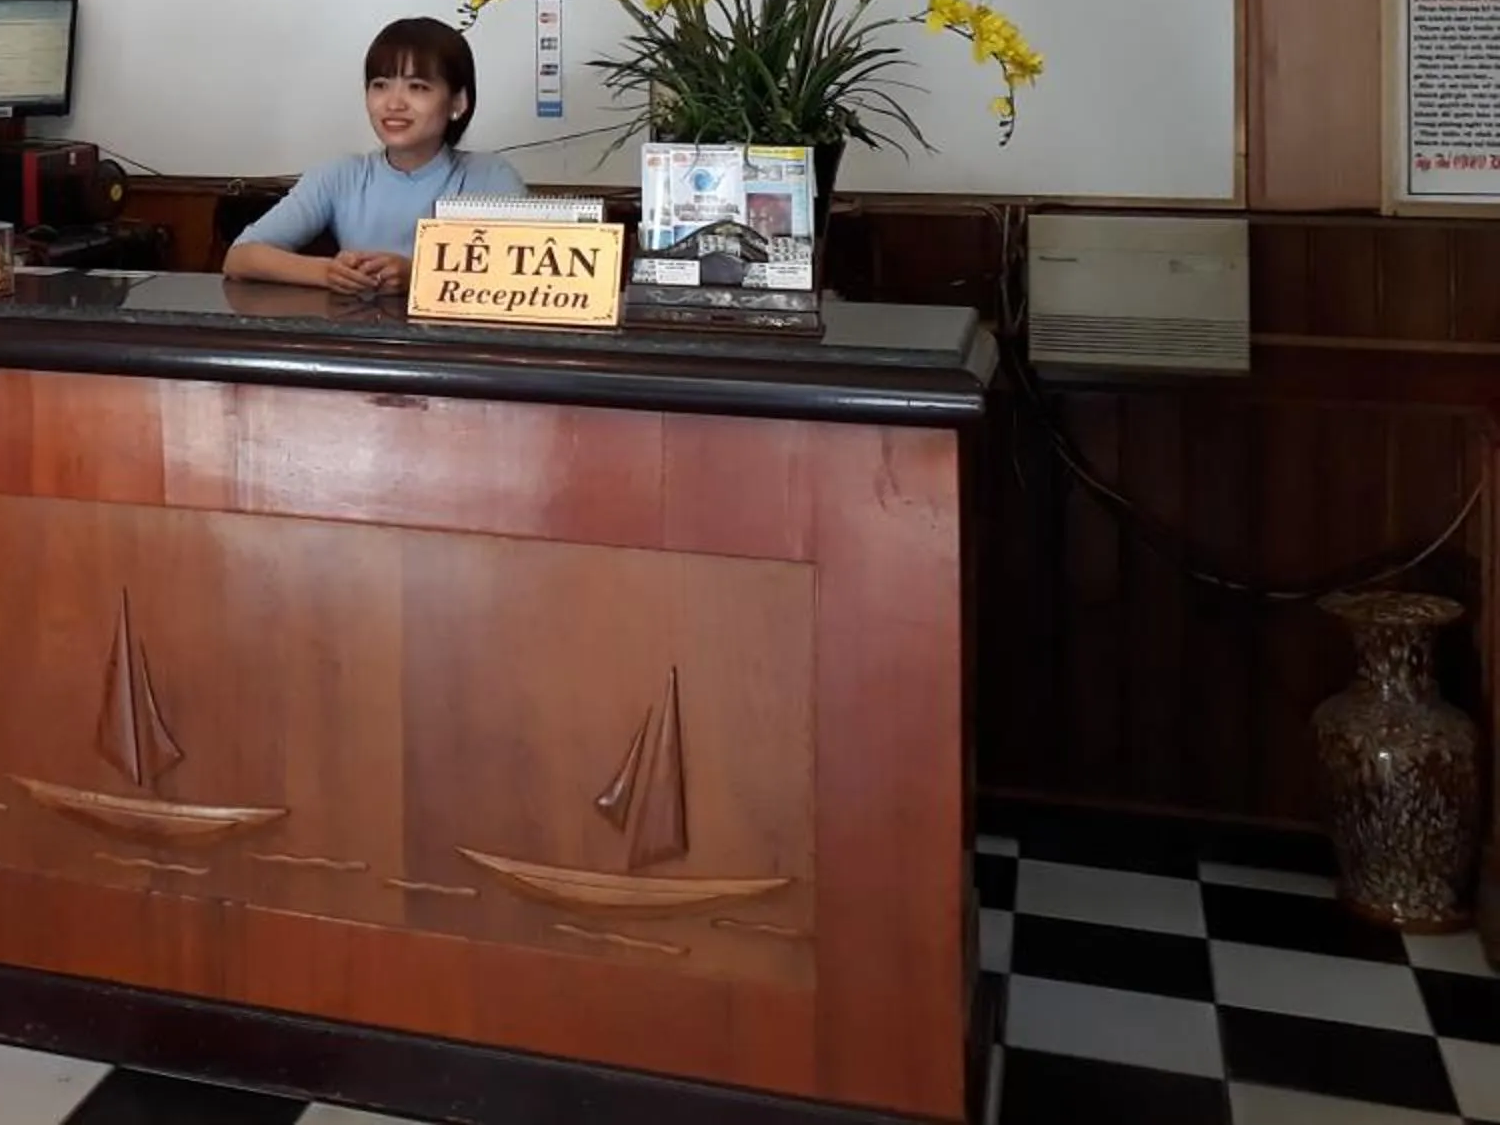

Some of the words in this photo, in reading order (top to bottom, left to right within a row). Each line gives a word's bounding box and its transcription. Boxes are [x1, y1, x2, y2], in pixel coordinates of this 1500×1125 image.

[433, 228, 490, 274] LỄ
[507, 236, 601, 278] TÂN
[437, 280, 589, 311] Reception
